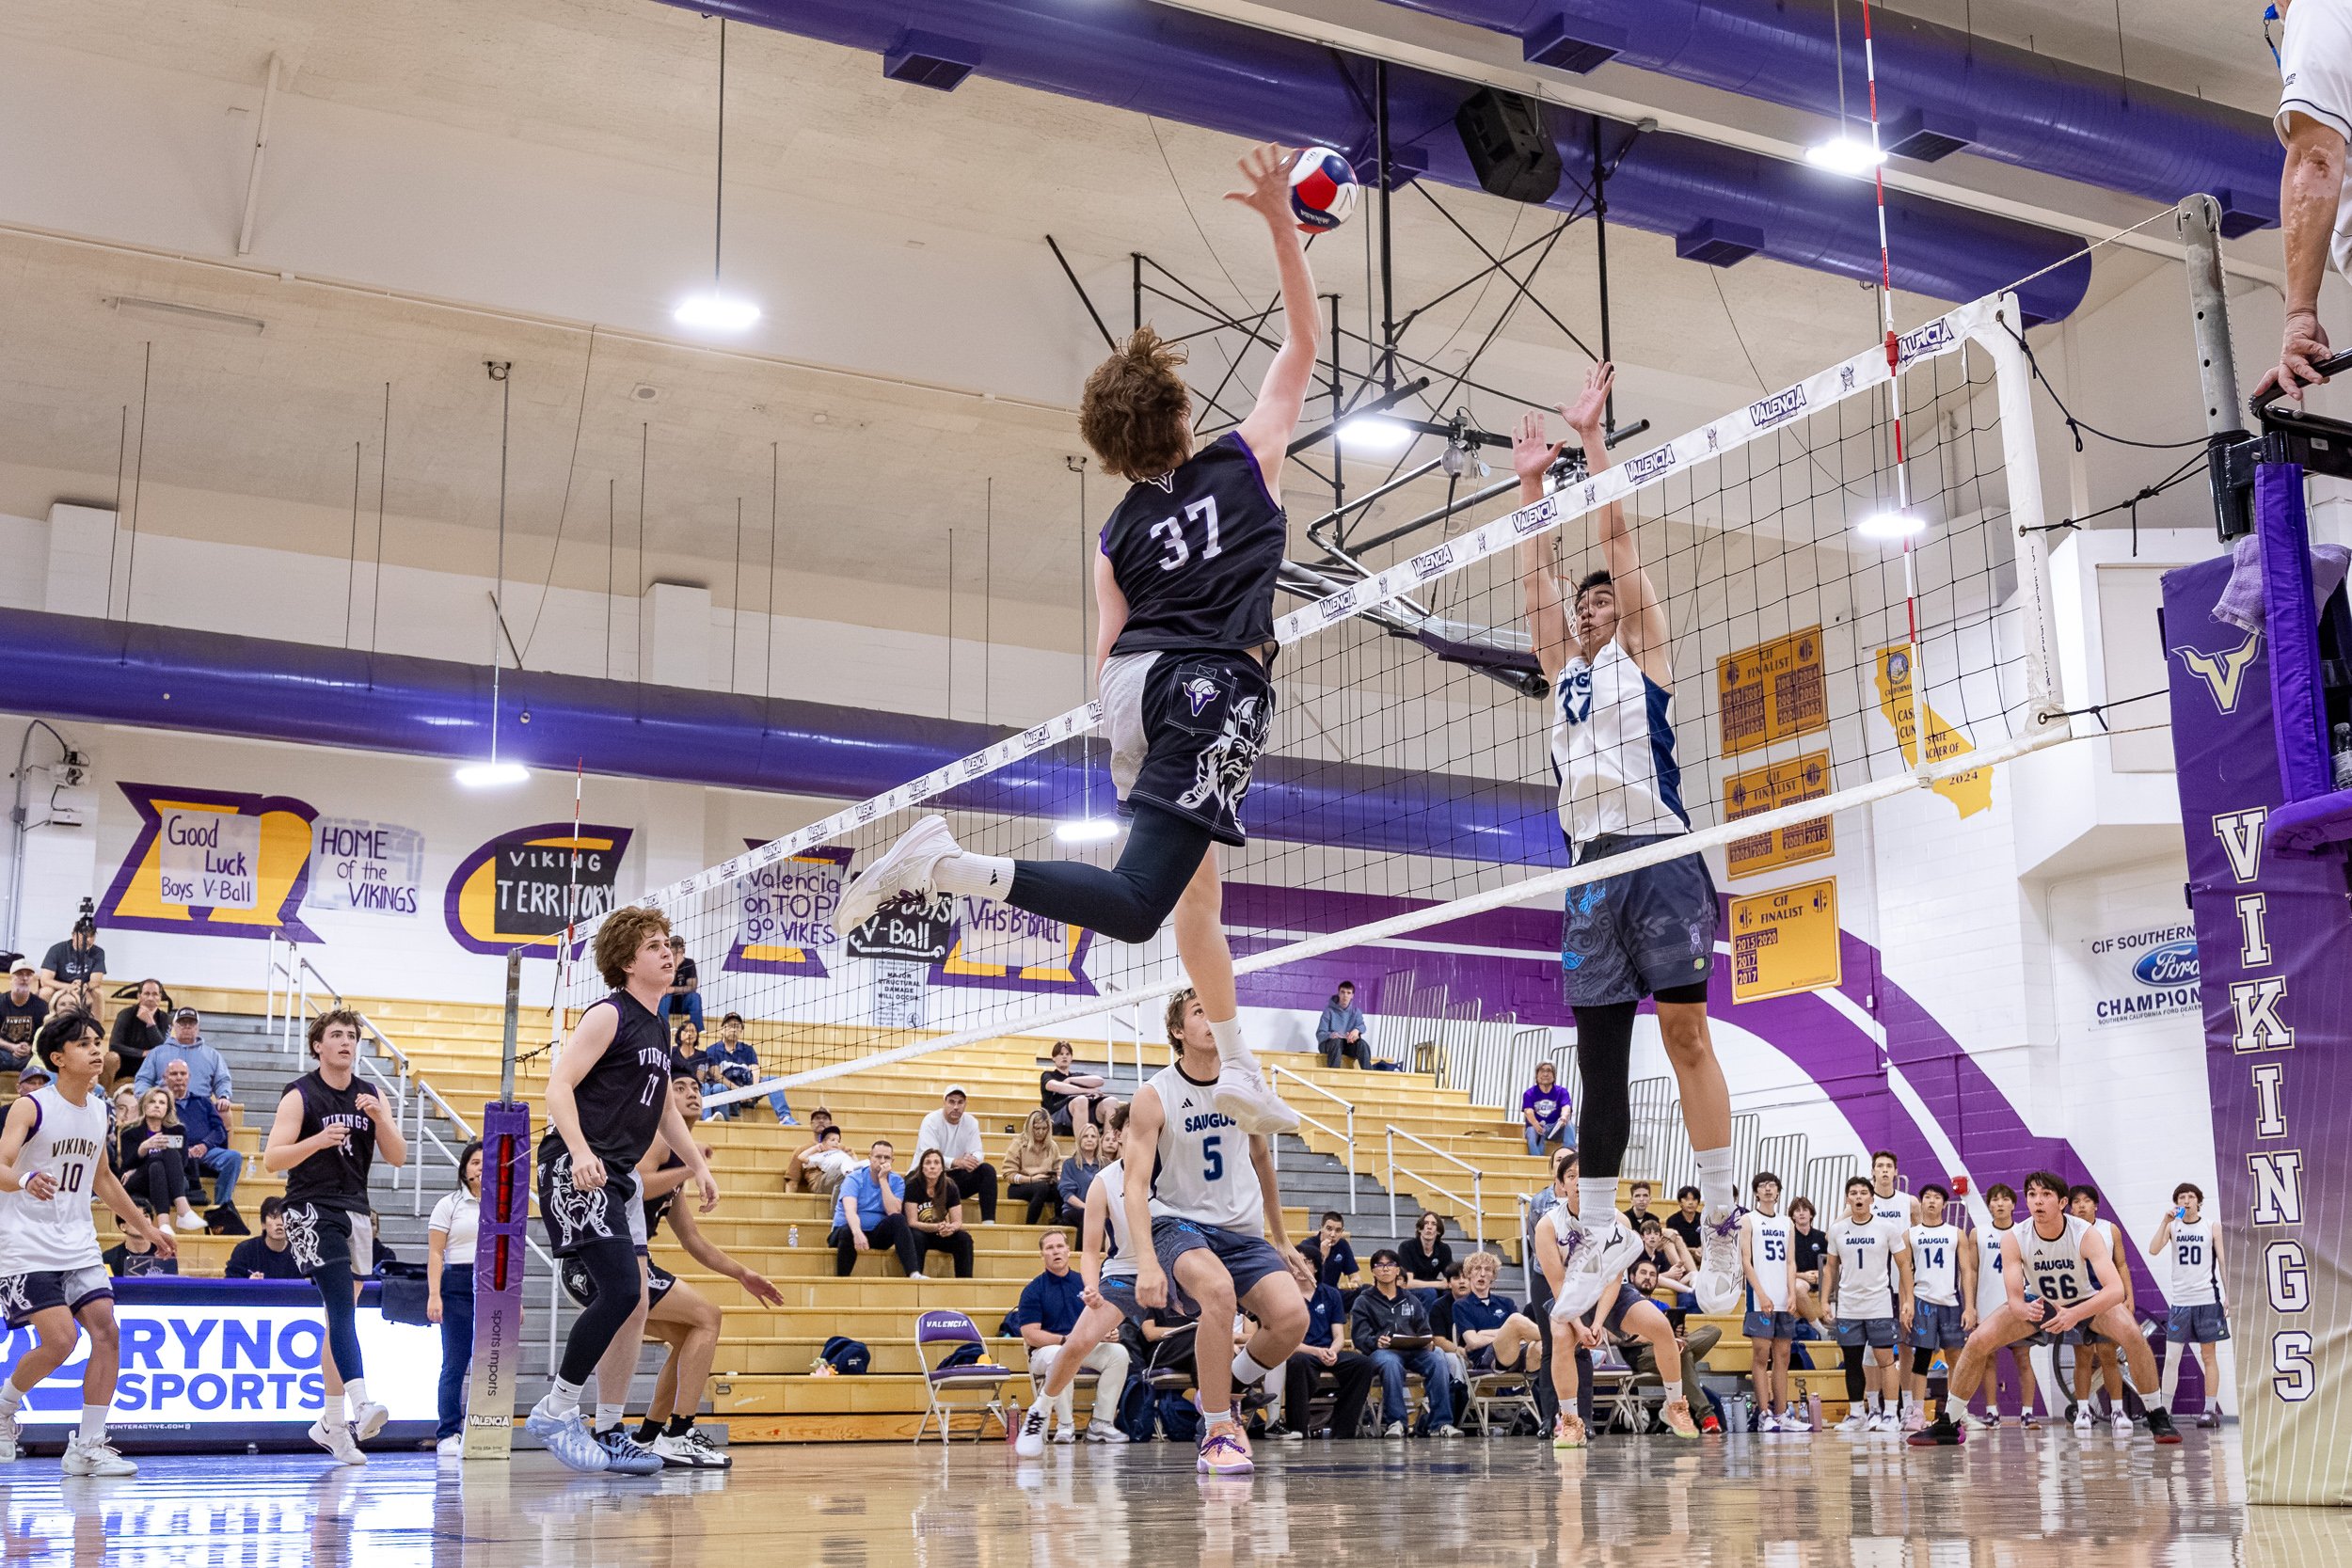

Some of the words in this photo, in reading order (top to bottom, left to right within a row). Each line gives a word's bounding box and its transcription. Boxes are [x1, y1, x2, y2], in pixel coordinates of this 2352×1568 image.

[1896, 318, 1954, 365] ALENCIA
[1749, 384, 1807, 426] VALENCIA
[1624, 444, 1676, 483] VALENCIA
[1512, 498, 1558, 533] VALENCIA
[1149, 495, 1223, 572] 37
[1411, 545, 1454, 578] VALENCIA
[1319, 587, 1358, 619] VALENCIA
[1747, 657, 1789, 679] FINALIST
[1949, 742, 1960, 754] OF
[1948, 770, 1979, 785] 2024
[1754, 780, 1796, 801] FINALIST
[167, 815, 218, 848] Good
[321, 827, 389, 860] HOME
[1805, 828, 1827, 845] 2015
[205, 850, 246, 877] Luck
[361, 861, 388, 881] the
[509, 850, 602, 873] VIKING
[162, 877, 194, 899] Boys
[203, 878, 251, 902] V-Ball
[749, 864, 840, 895] Valencia
[348, 883, 417, 913] VIKINGS
[497, 879, 616, 918] TERRITORY
[744, 896, 770, 913] on
[1773, 895, 1788, 908] CIF
[963, 896, 1008, 932] VHS
[1761, 906, 1804, 924] FINALIST
[781, 919, 835, 945] VIKES
[861, 916, 930, 950] V-Ball
[1737, 937, 1756, 951] 2015
[1757, 932, 1777, 947] 2020
[2091, 938, 2114, 954] CIF
[2118, 925, 2196, 950] SOUTHERN
[1738, 954, 1756, 969] 2017
[878, 978, 921, 988] STRUCTURAL
[884, 986, 914, 994] DAMAGE
[1739, 970, 1757, 986] 2017
[2098, 1014, 2127, 1025] SOUTHERN
[2129, 1009, 2162, 1022] CALIFORNIA
[2163, 1006, 2179, 1016] FORD
[640, 1073, 659, 1107] 17
[2213, 806, 2315, 1402] VIKINGS
[322, 1114, 369, 1131] VIKINGS
[1202, 1136, 1224, 1181] 5
[58, 1163, 83, 1193] 10
[1765, 1240, 1787, 1261] 53
[1845, 1237, 1876, 1245] SAUGUS
[1857, 1249, 1864, 1270] 1
[1924, 1247, 1944, 1269] 14
[2033, 1259, 2074, 1272] SAUGUS
[2179, 1245, 2201, 1265] 20
[2039, 1274, 2078, 1300] 66
[492, 1309, 502, 1345] sports
[926, 1320, 968, 1329] VALENCIA
[119, 1319, 326, 1370] RYNO
[487, 1349, 500, 1397] imports
[116, 1373, 326, 1410] SPORTS
[469, 1415, 510, 1428] VALENCIA
